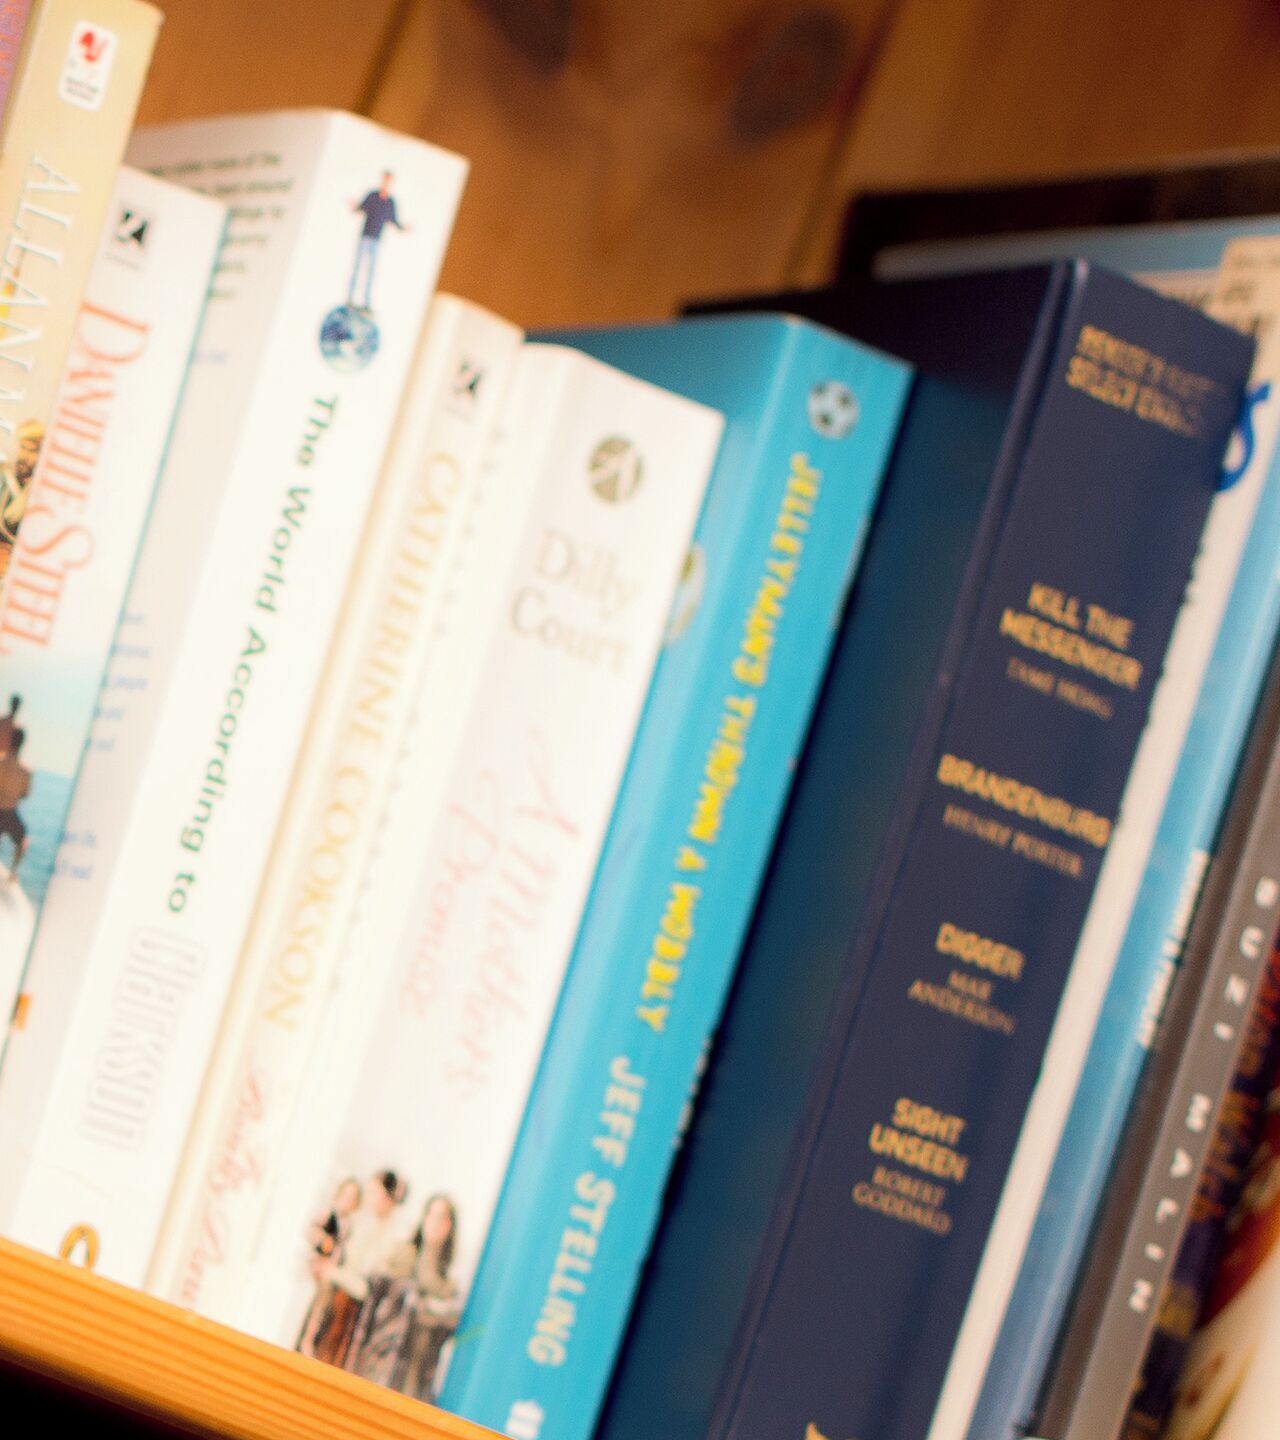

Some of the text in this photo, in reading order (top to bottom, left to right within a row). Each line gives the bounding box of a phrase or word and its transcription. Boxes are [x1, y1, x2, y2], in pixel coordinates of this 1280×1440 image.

[342, 450, 463, 750] CATHERINE
[510, 590, 627, 673] Court
[1086, 603, 1136, 650] THE
[167, 392, 338, 915] The World According to
[998, 606, 1144, 690] MESSENGER
[263, 762, 370, 1031] COOKSON
[675, 847, 707, 873] A
[936, 922, 1025, 982] DIGGER
[869, 1123, 969, 1183] UNSEEN
[893, 1098, 968, 1146] SIGHT
[528, 1055, 650, 1368] JEFF STELLING
